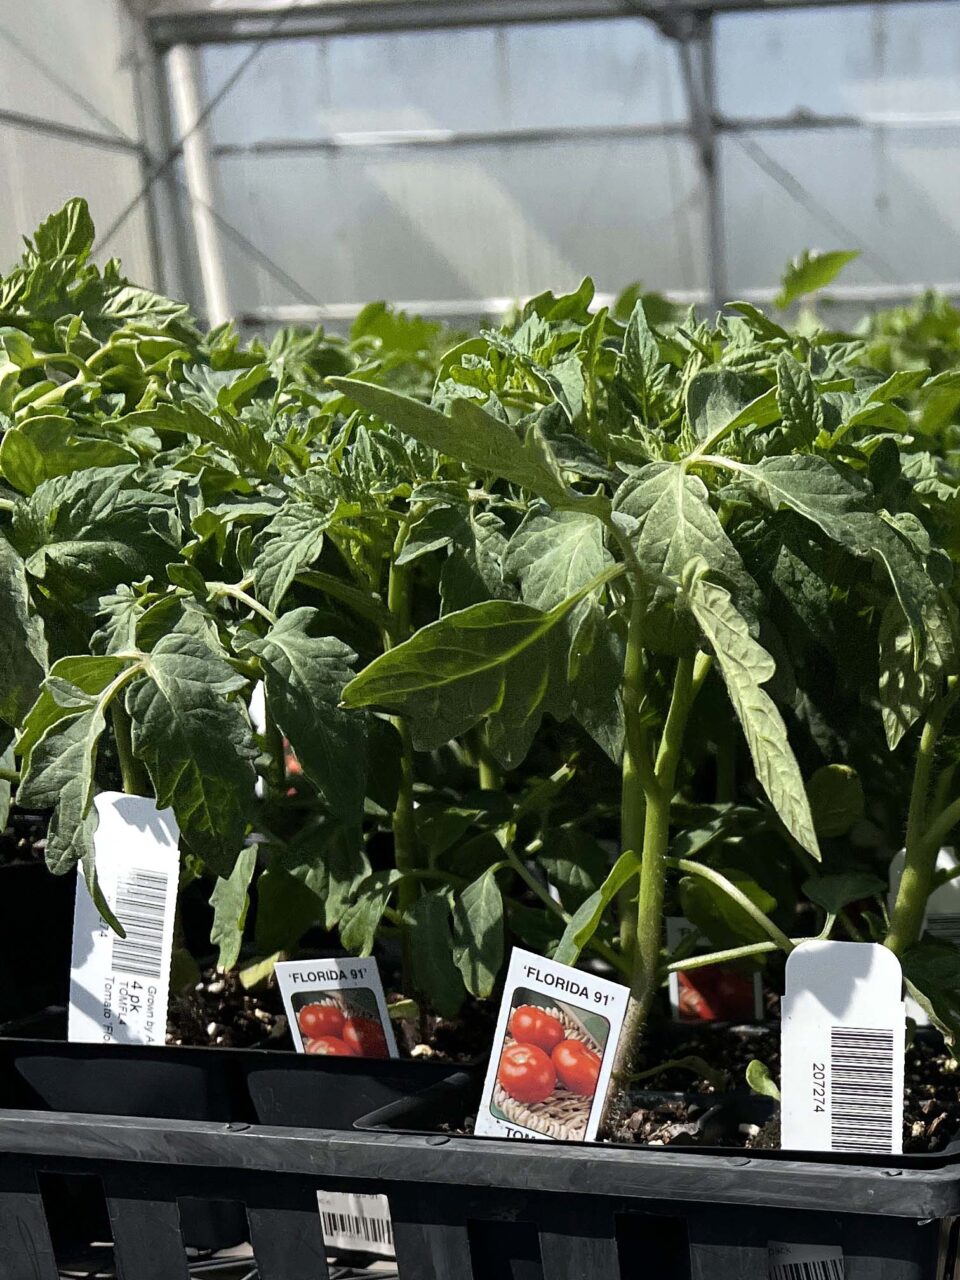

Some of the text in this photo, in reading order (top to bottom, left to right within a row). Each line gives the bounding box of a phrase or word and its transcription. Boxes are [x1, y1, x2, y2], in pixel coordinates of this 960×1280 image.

[288, 967, 368, 983] ‘FLORIDA 91’
[523, 964, 615, 1006] ‘FLORIDA 91’
[103, 976, 115, 1019] Tomato
[128, 980, 144, 1014] 4 pk
[812, 1062, 826, 1113] 207274
